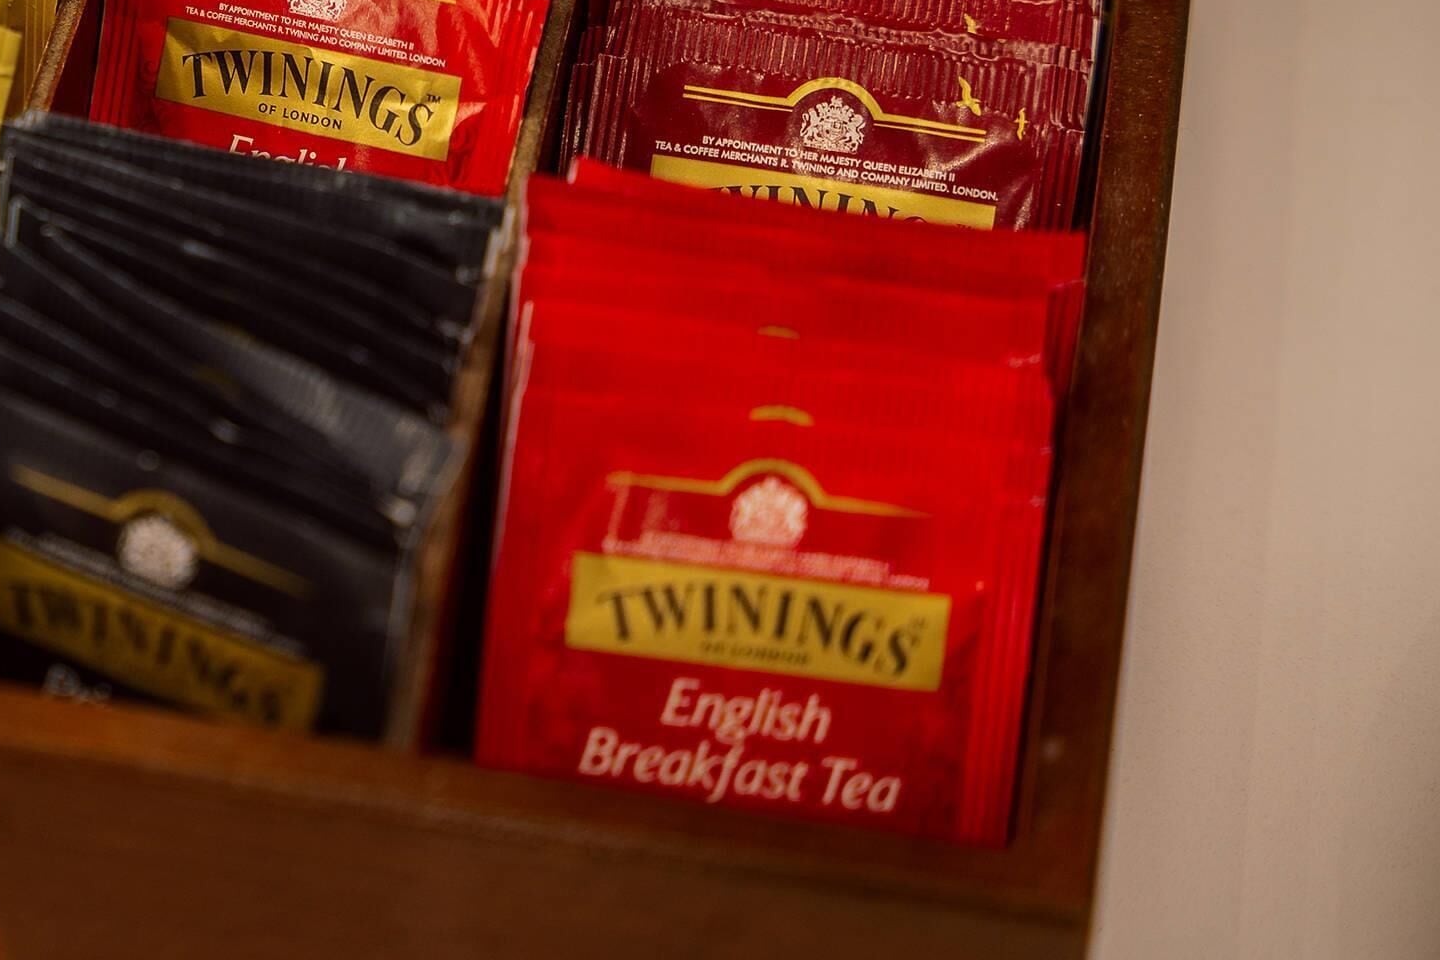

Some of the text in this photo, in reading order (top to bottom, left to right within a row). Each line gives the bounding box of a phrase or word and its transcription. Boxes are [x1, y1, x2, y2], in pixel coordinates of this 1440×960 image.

[185, 6, 199, 16] TEA
[206, 11, 233, 23] COFFEE
[234, 16, 277, 32] MERCHANTS
[285, 27, 319, 41] TWINING
[320, 35, 338, 45] AND
[339, 38, 376, 53] COMPANY
[409, 54, 447, 67] LONDON
[219, 2, 229, 11] BY
[229, 4, 279, 21] APPOINTMENT
[280, 16, 291, 24] TO
[292, 18, 307, 27] HER
[308, 21, 339, 35] MAJESTY
[340, 28, 367, 41] QUEEN
[367, 34, 408, 49] ELIZABETH
[181, 49, 434, 146] TWININGS
[258, 103, 342, 130] OF LONDON
[655, 140, 672, 151] TEA
[683, 144, 720, 158] COFFEE
[721, 148, 778, 167] MERCHANTS
[791, 160, 835, 176] TWINING
[836, 167, 859, 179] AND
[860, 170, 911, 186] COMPANY
[702, 136, 715, 145] BY
[715, 138, 783, 156] APPOINTMENT
[785, 148, 798, 157] TO
[800, 151, 818, 162] HER
[819, 154, 861, 168] MAJESTY
[863, 160, 897, 173] QUEEN
[898, 165, 947, 181] ELIZABETH
[596, 581, 921, 678] TWININGS
[662, 678, 832, 744] English
[579, 727, 901, 813] Breakfast Tea
